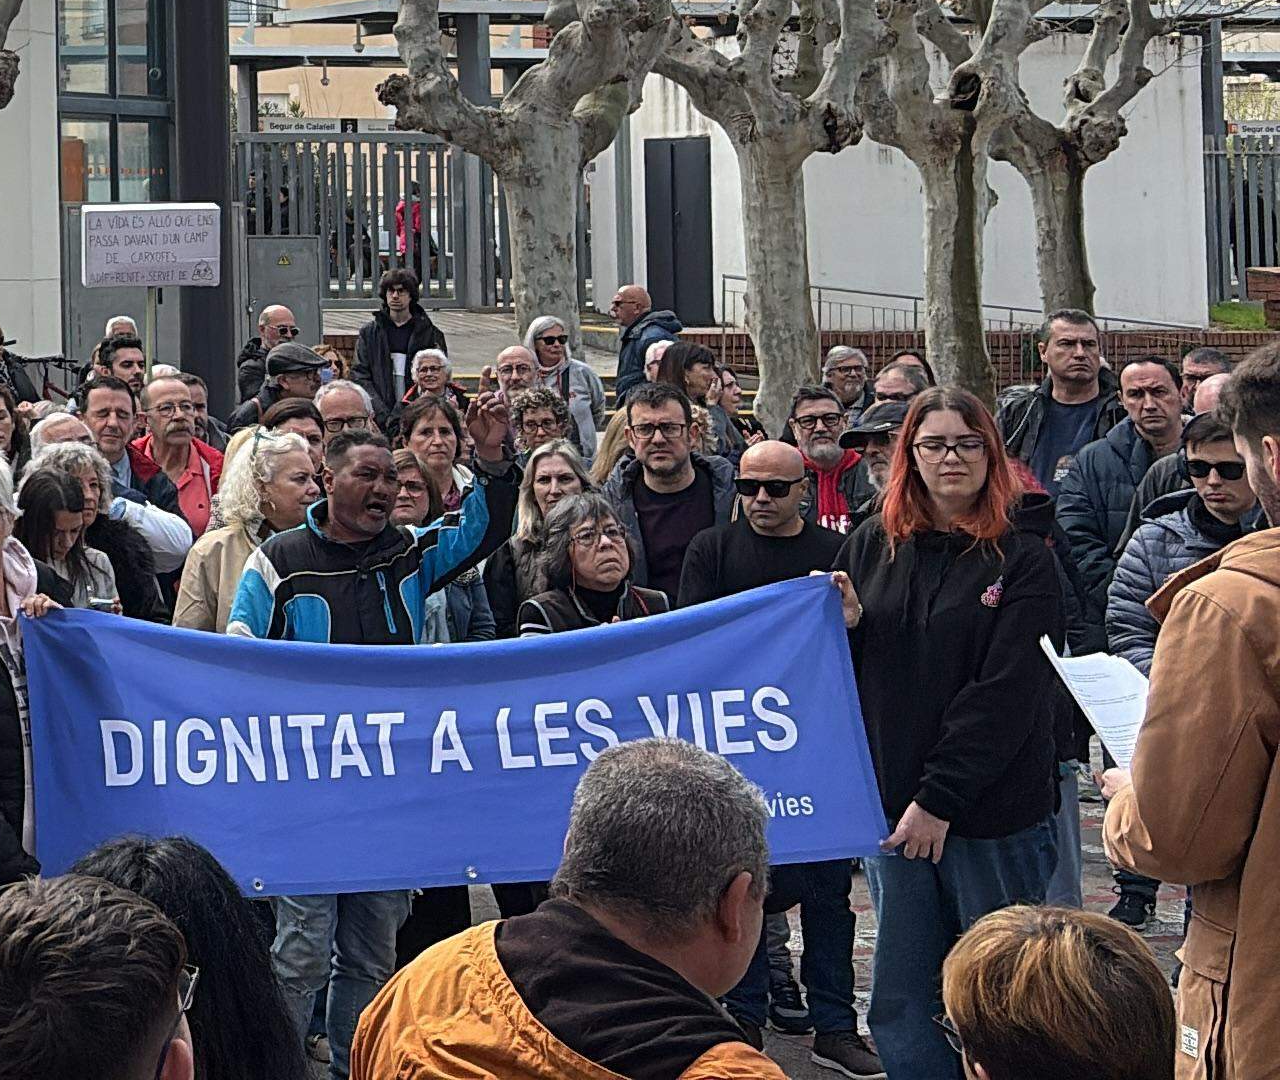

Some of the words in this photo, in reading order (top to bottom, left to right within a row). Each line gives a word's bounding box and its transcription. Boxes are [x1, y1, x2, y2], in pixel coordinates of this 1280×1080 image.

[269, 122, 293, 132] Segur
[294, 122, 305, 130] de
[306, 122, 336, 131] Calafell
[88, 217, 103, 231] LA
[108, 215, 130, 230] VIDA
[175, 215, 194, 227] QUE
[89, 235, 120, 247] PASSA
[124, 233, 158, 247] DAVANT
[184, 231, 208, 244] CAMP
[105, 252, 120, 264] DE
[100, 712, 407, 787] DIGNITAT
[431, 710, 474, 773] A
[500, 698, 618, 770] LES
[638, 686, 800, 756] VIES
